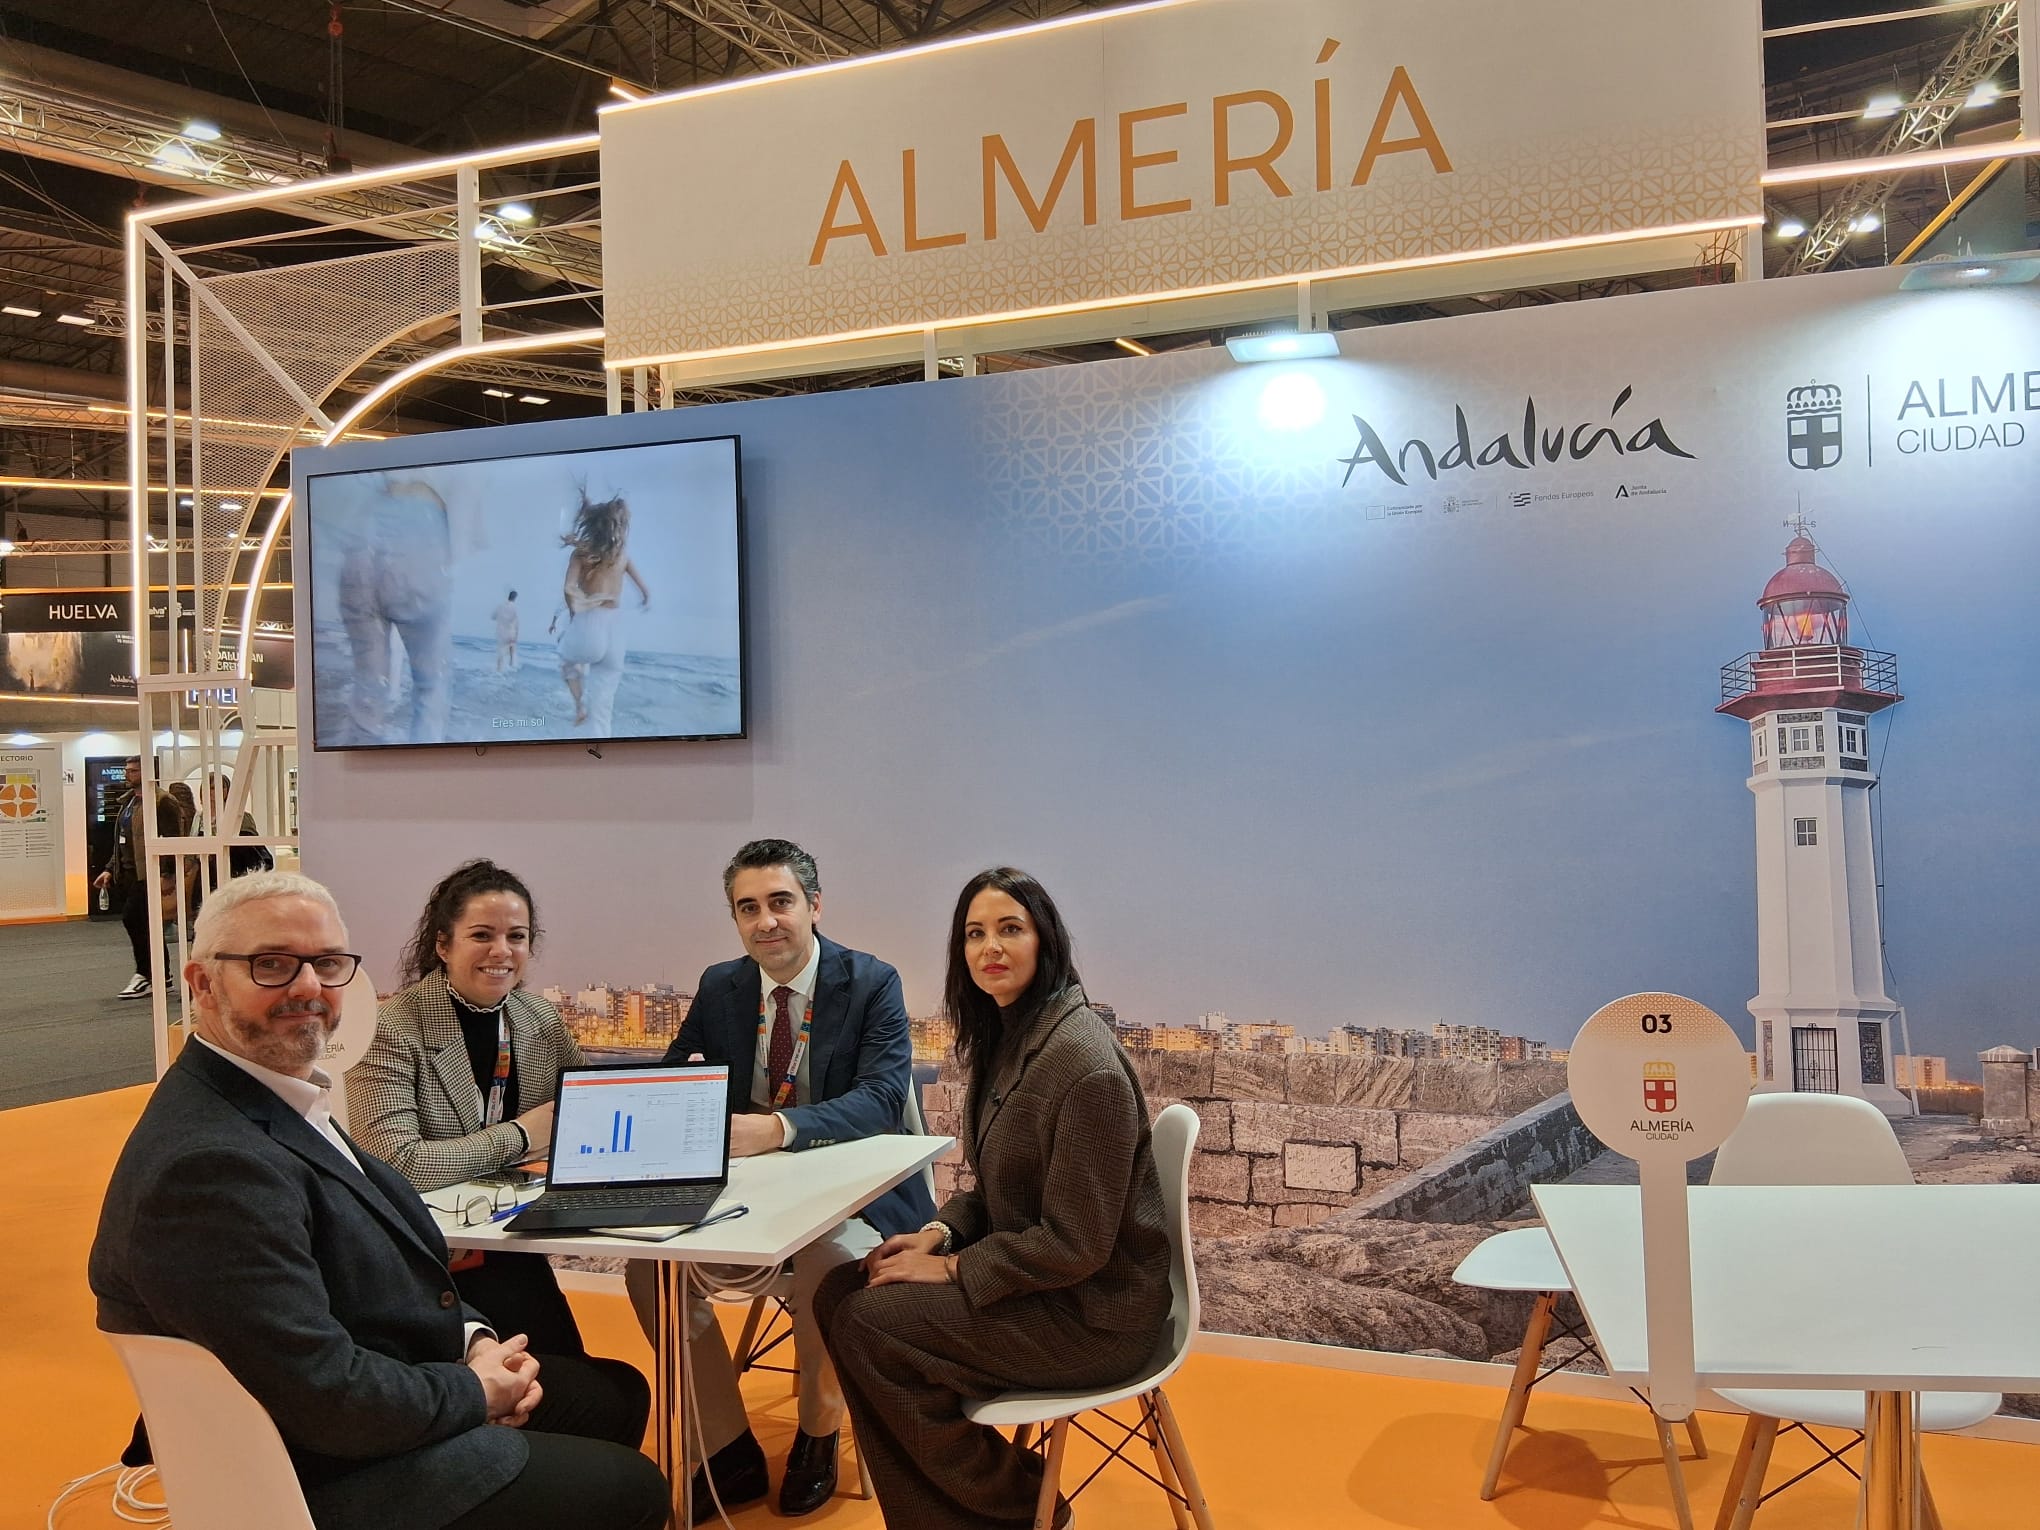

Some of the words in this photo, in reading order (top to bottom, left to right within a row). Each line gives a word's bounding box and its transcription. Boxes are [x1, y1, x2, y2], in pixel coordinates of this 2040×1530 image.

[808, 38, 1453, 266] ALMERÍA
[1336, 384, 1698, 488] Andalucía
[1897, 422, 2025, 454] CIUDAD
[1534, 493, 1560, 501] Fondos
[1561, 491, 1594, 500] Europeos
[49, 604, 118, 619] HUELVA
[492, 717, 514, 728] Eres
[530, 715, 545, 727] sol
[1641, 1014, 1673, 1034] 03
[1630, 1118, 1694, 1133] ALMERÍA
[1645, 1132, 1679, 1141] CIUDAD
